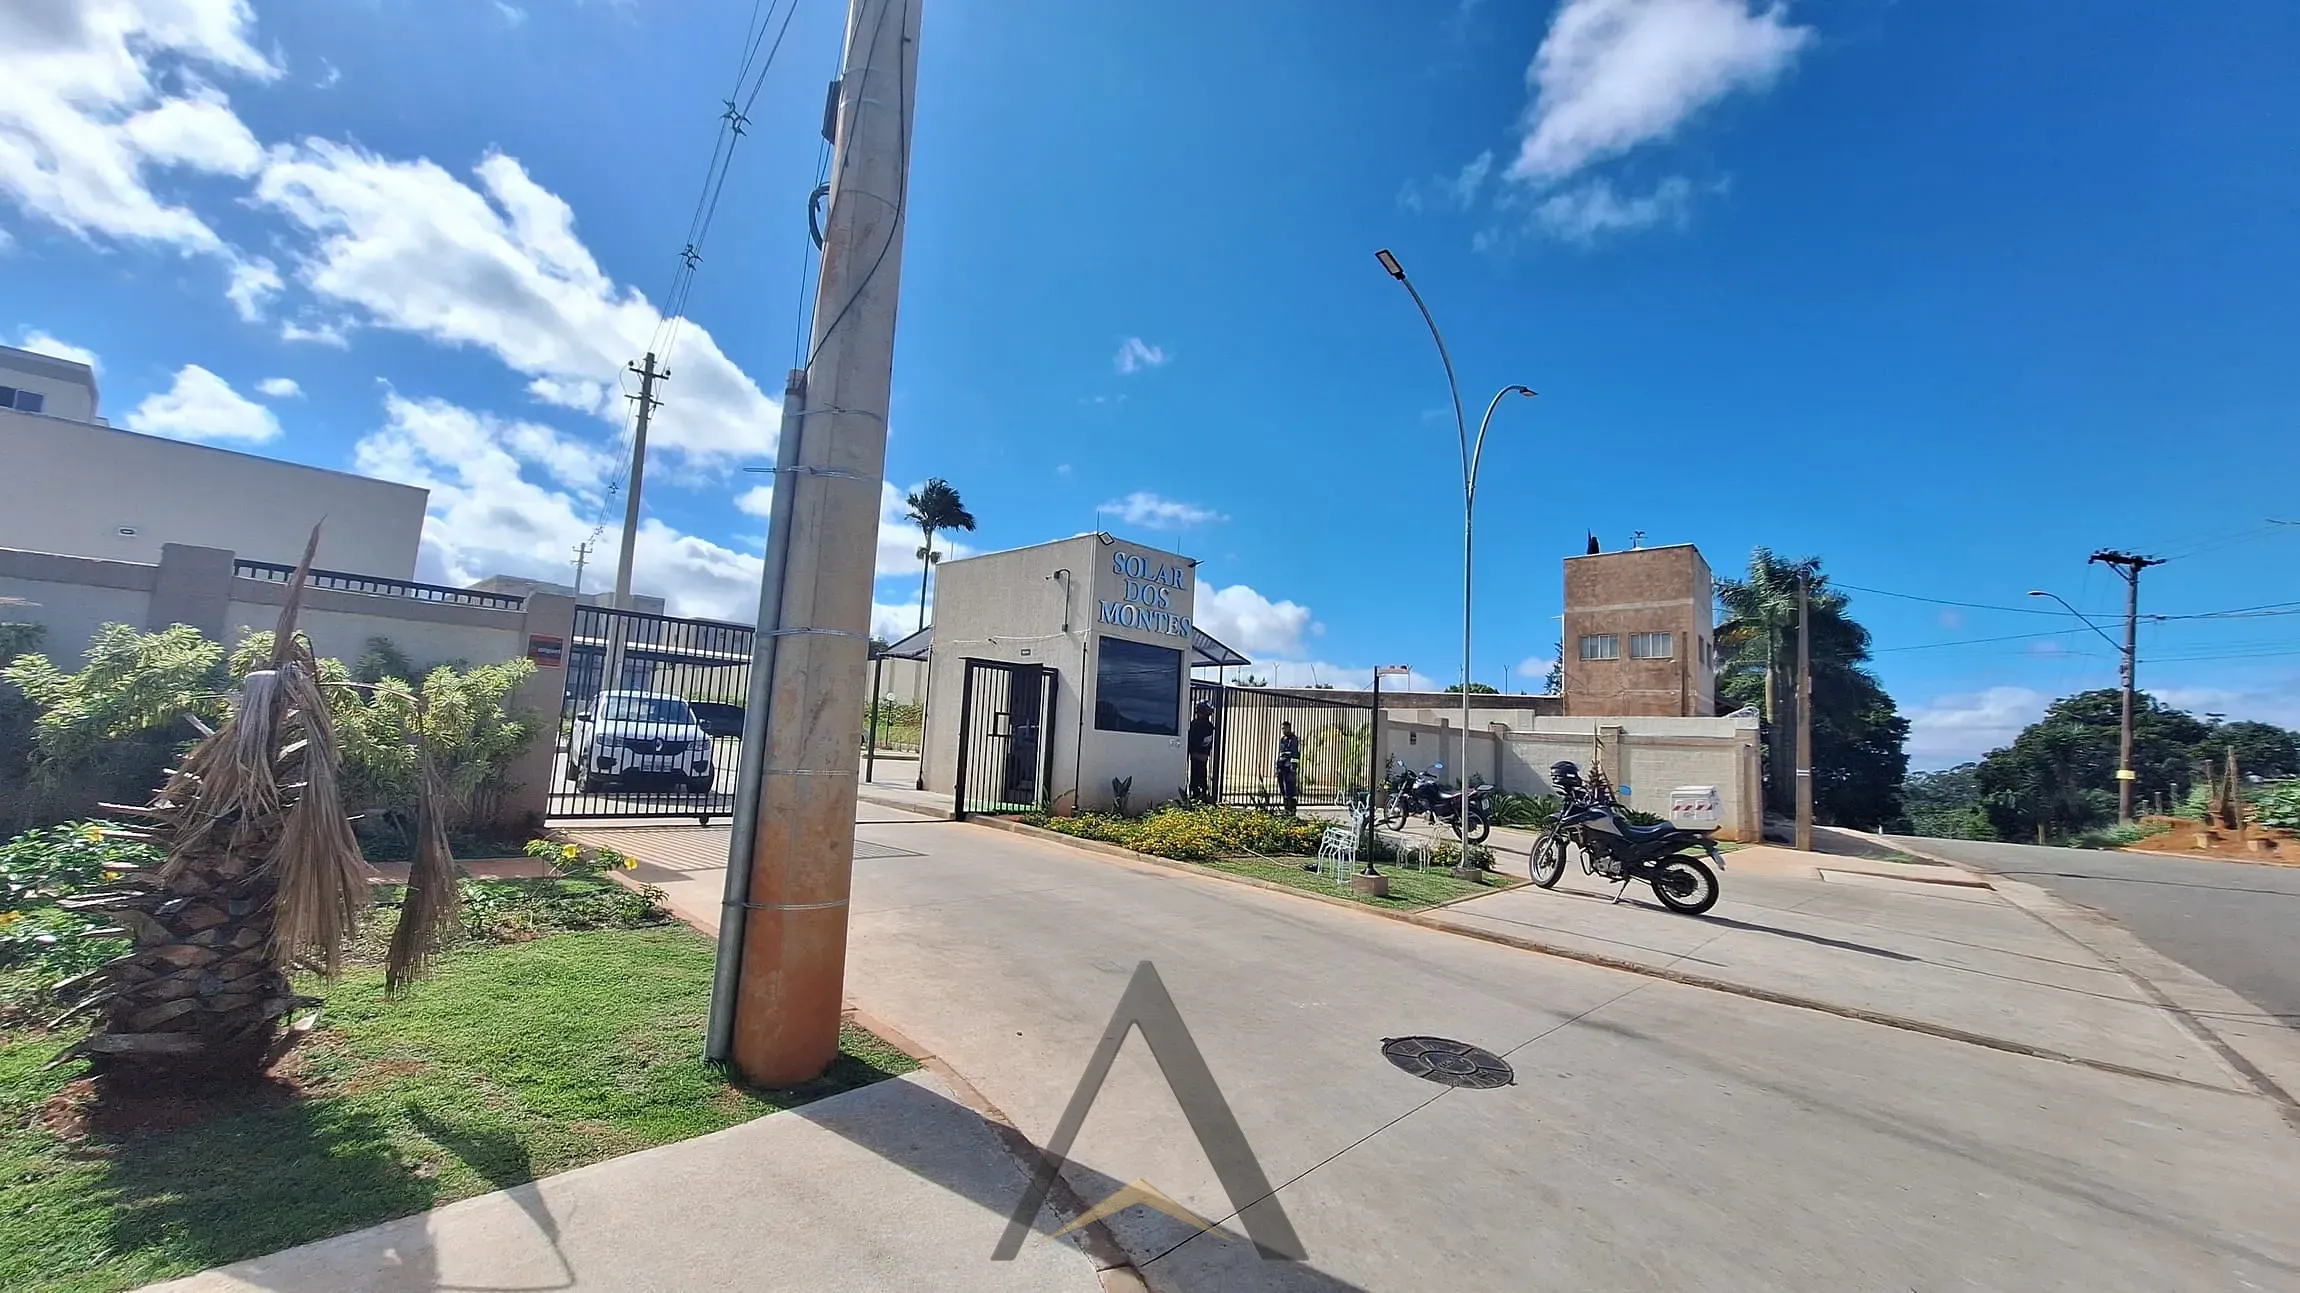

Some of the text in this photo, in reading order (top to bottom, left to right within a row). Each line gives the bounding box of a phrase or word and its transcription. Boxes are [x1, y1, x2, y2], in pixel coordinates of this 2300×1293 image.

[1112, 551, 1184, 590] SOLAR
[1124, 579, 1170, 609] DOS
[1097, 600, 1193, 638] MONTES
